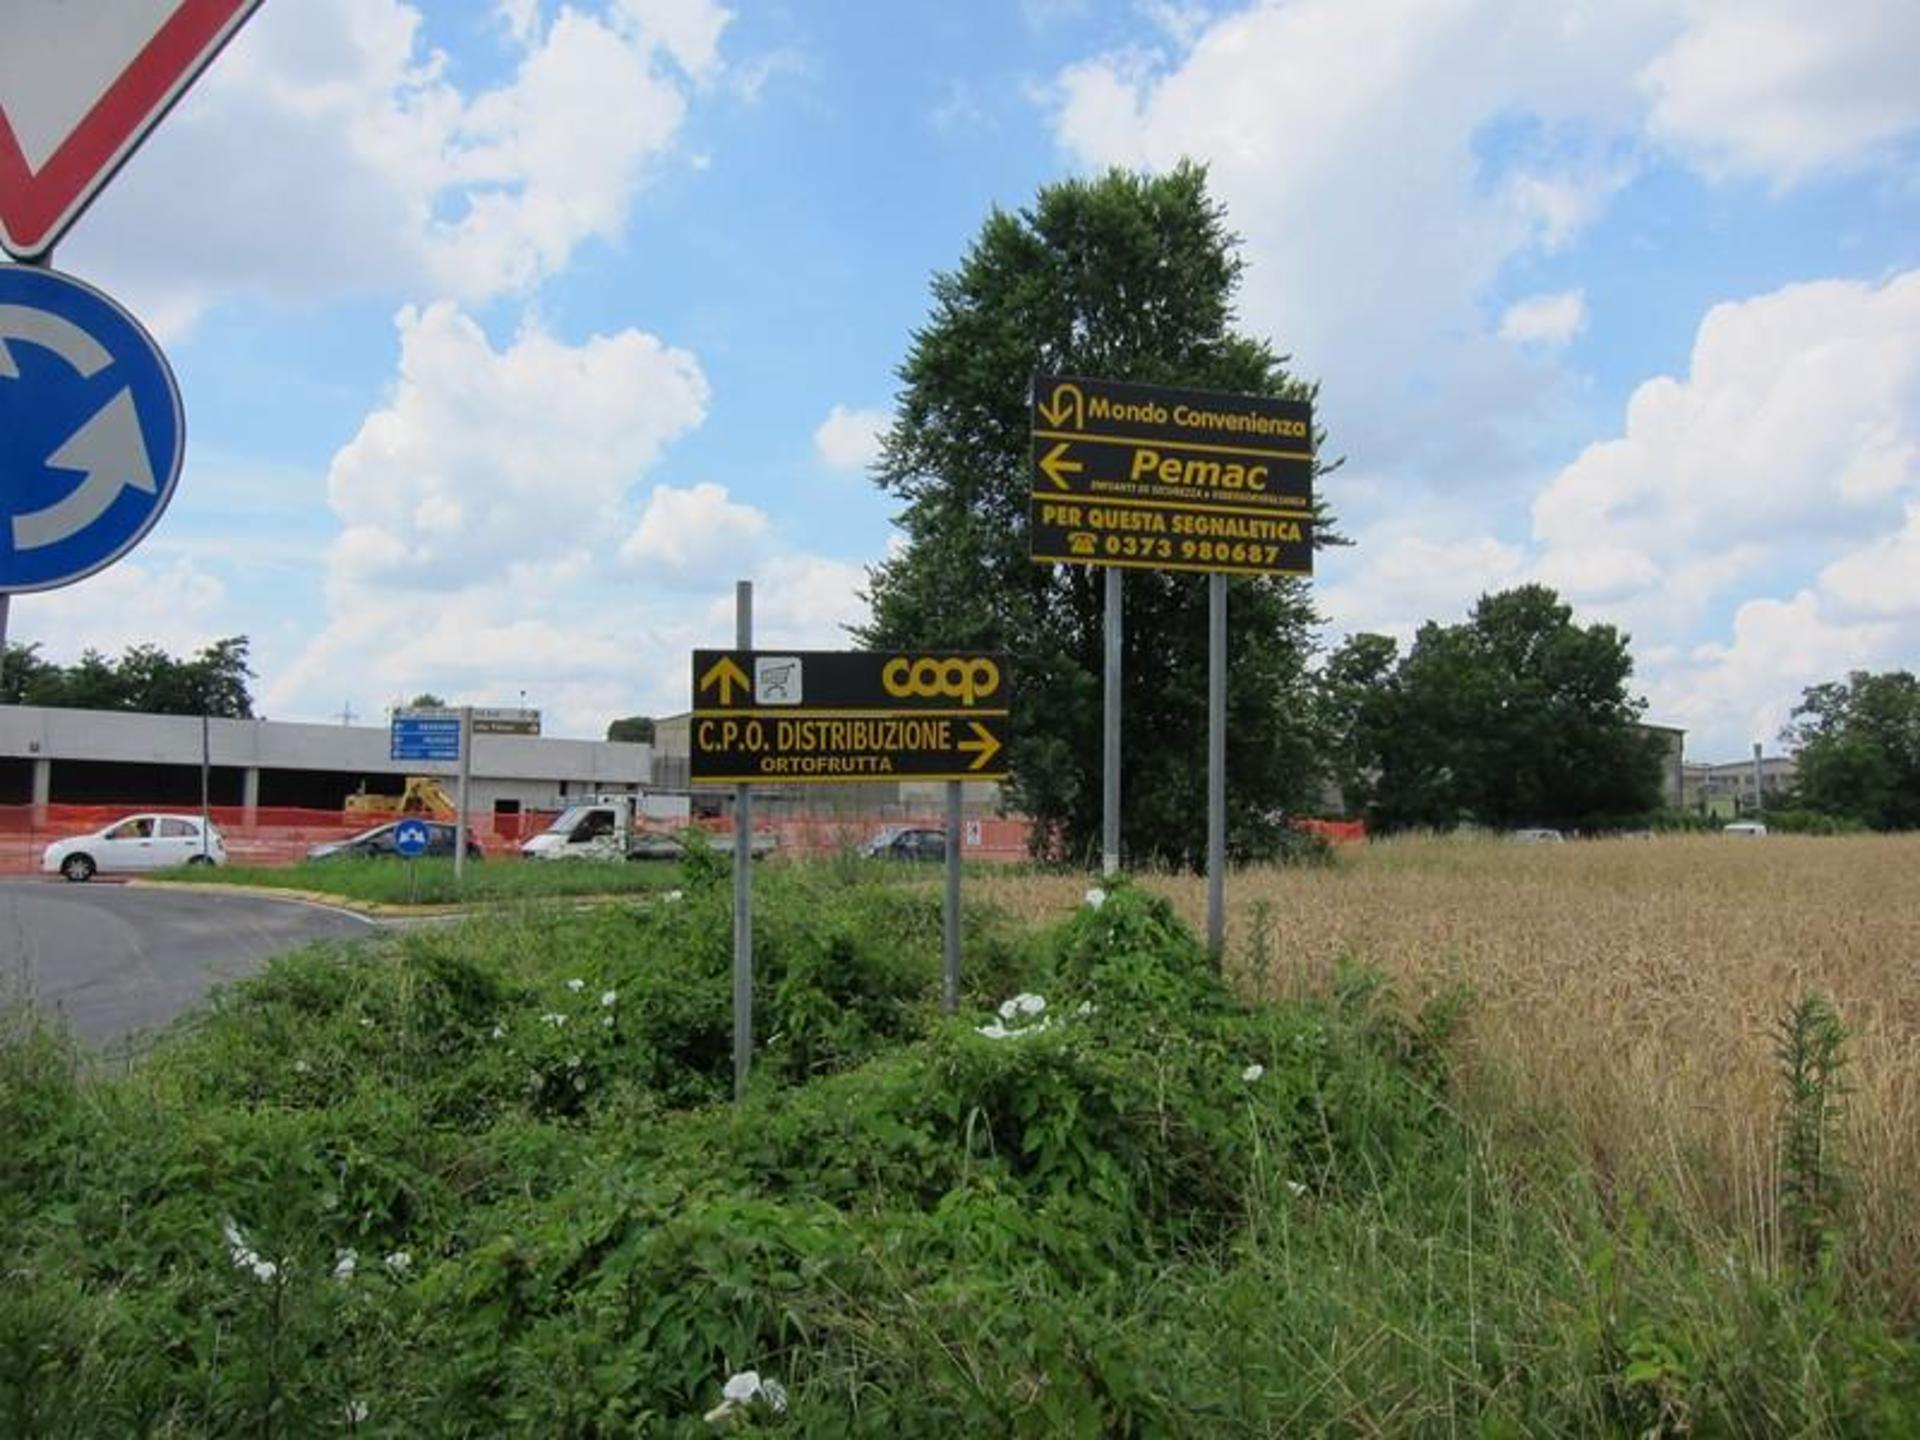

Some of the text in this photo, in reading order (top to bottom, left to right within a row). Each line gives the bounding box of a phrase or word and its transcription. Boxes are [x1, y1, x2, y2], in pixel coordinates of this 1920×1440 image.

[1089, 398, 1307, 438] Mondo Convenienza
[1130, 450, 1269, 490] Pemac
[1042, 506, 1303, 541] PER QUESTA SEGNALETICA
[1106, 536, 1280, 565] 0373 980687
[882, 657, 1000, 706] coop
[699, 721, 951, 751] C.P.O. DISTRIBUZIONE
[760, 757, 893, 773] ORTOFRUTTA
